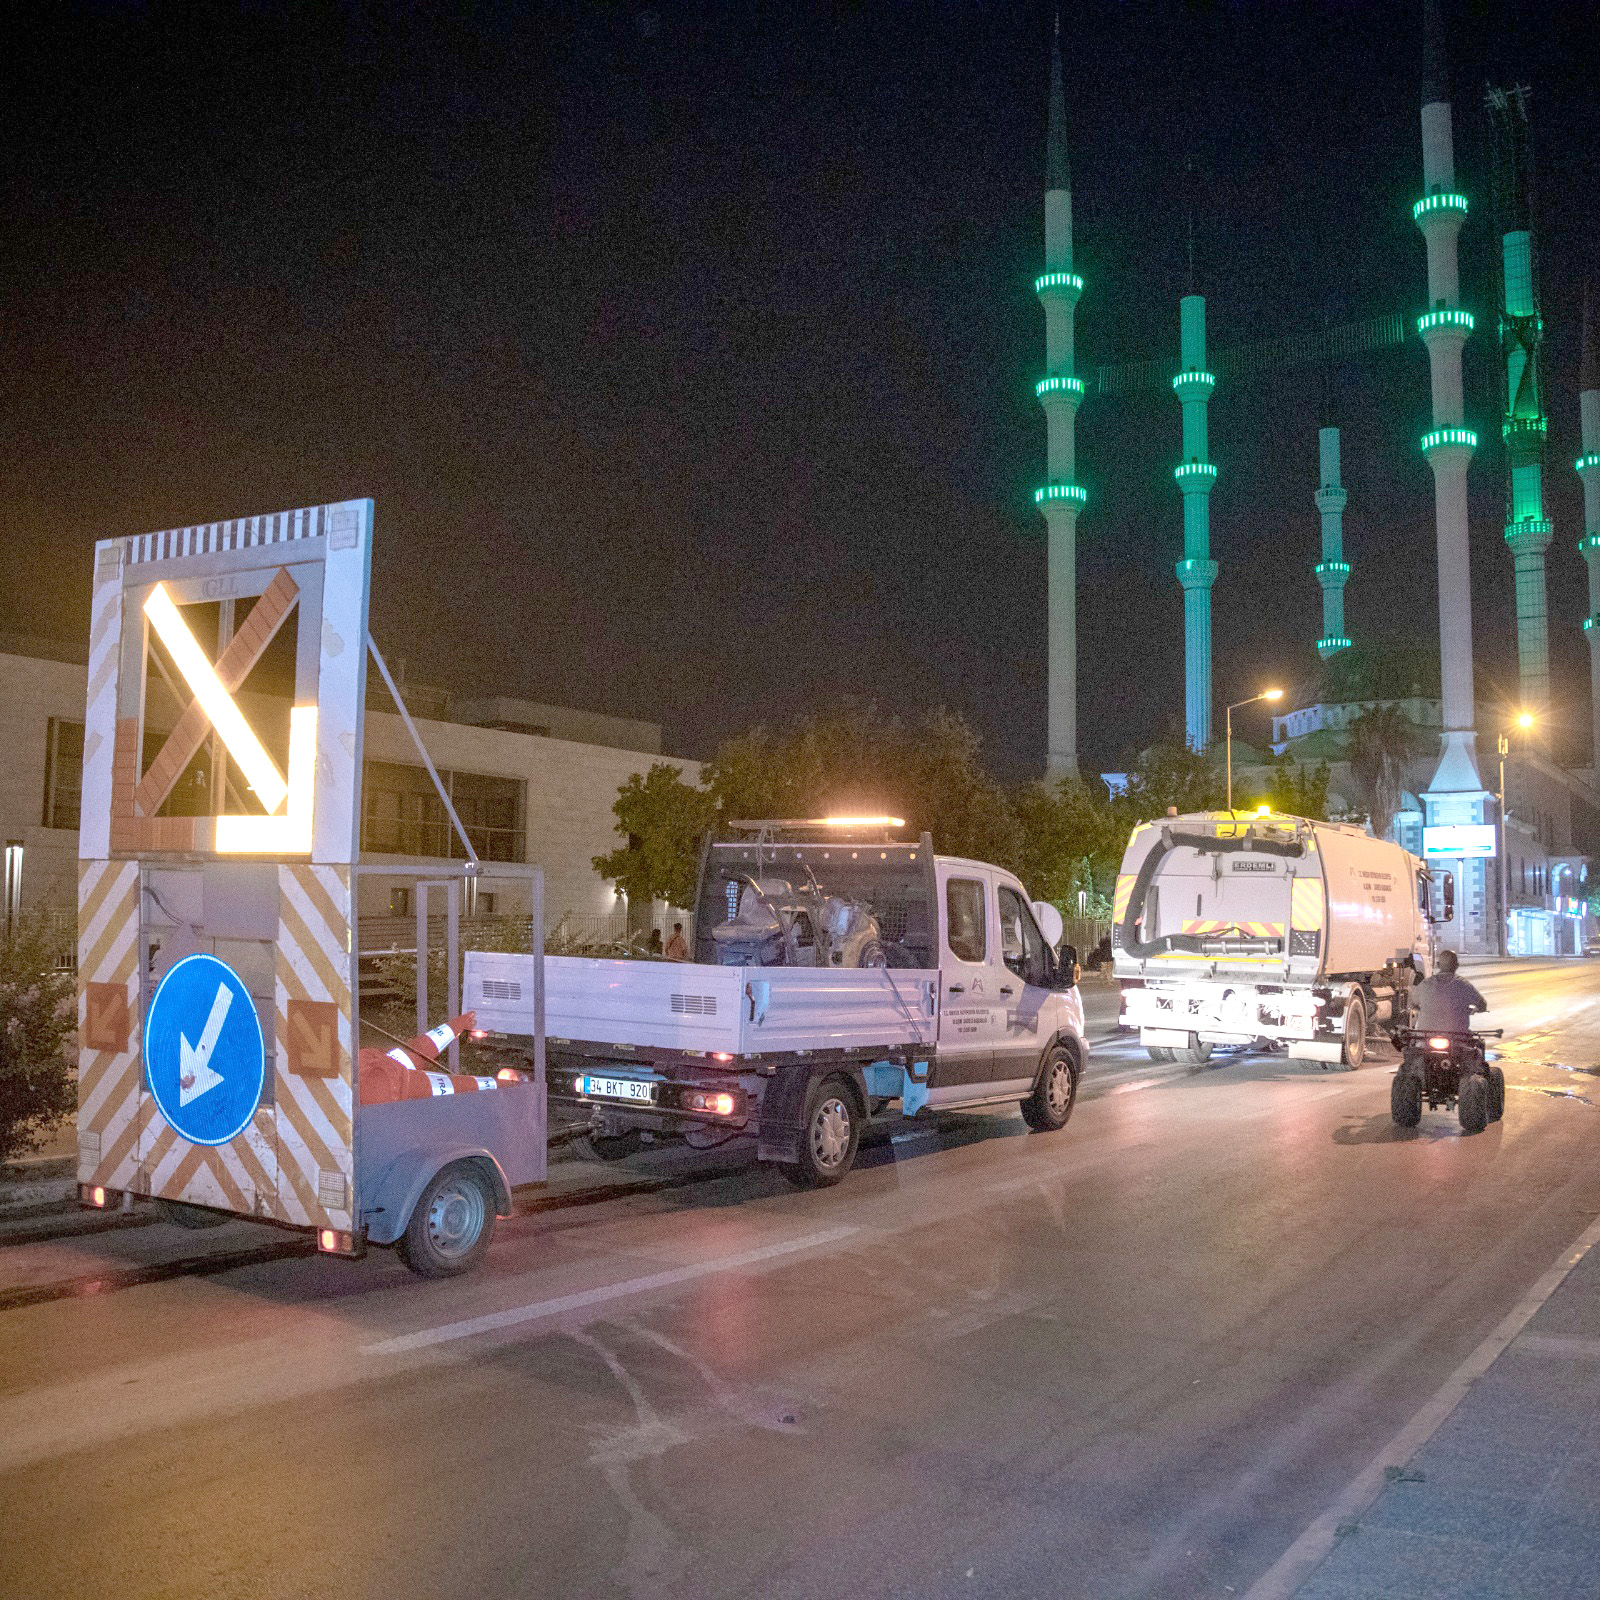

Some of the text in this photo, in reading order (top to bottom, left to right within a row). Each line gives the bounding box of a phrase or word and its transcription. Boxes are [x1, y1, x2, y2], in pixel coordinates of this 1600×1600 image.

[590, 1079, 648, 1098] 34 BKT 920
